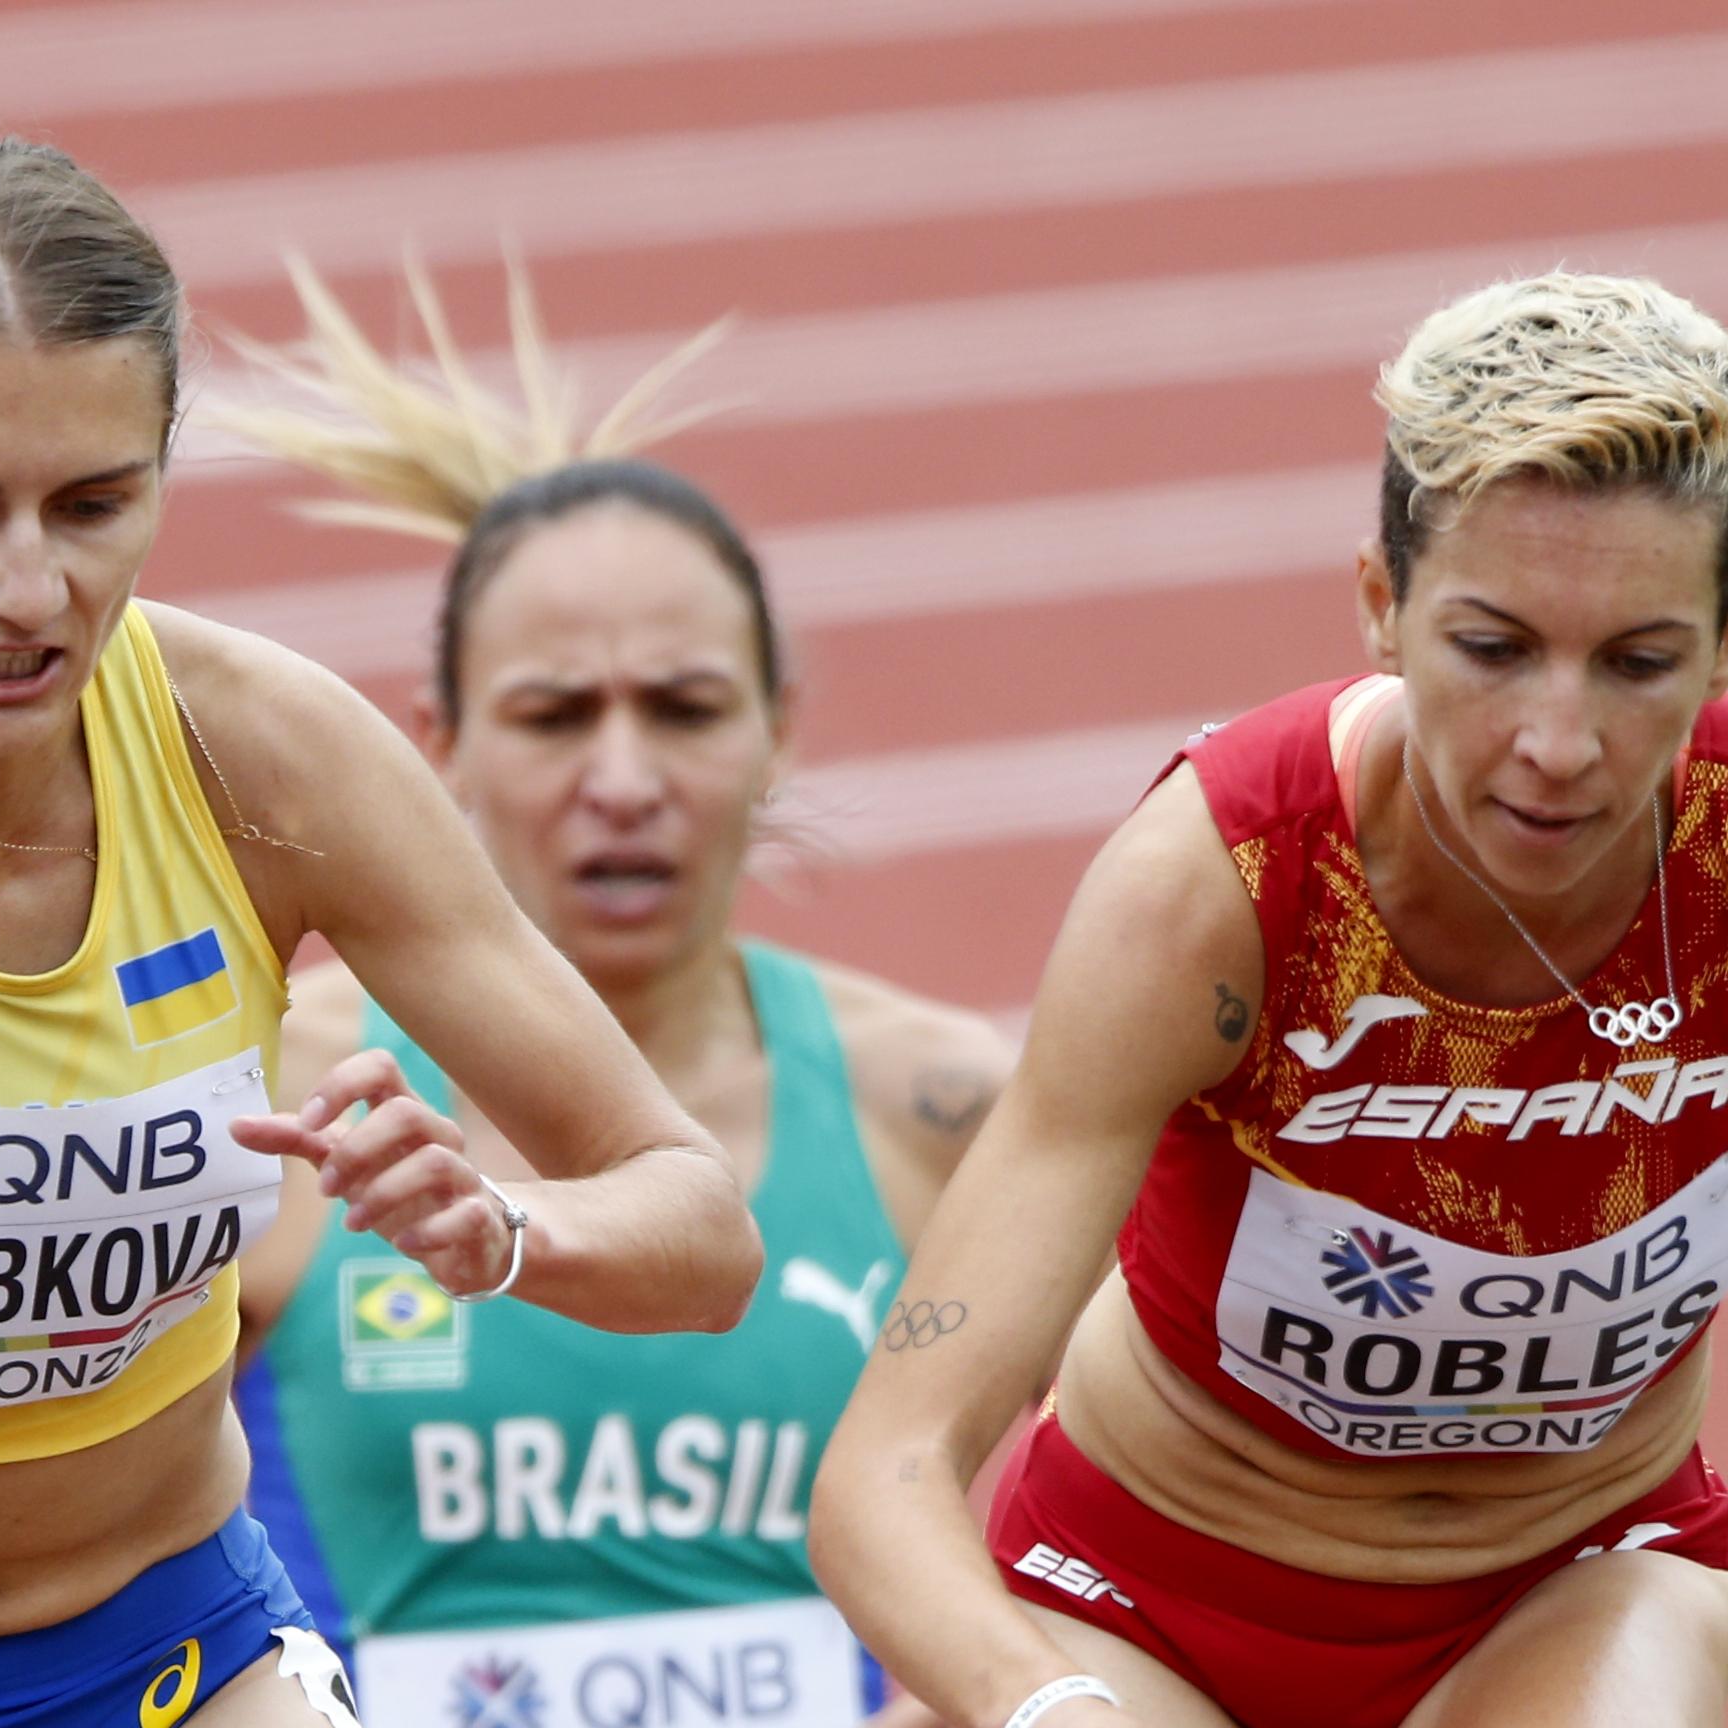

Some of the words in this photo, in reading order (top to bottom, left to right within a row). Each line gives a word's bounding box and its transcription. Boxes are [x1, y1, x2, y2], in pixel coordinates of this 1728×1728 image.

[1458, 1215, 1691, 1320] QNB
[1259, 1279, 1719, 1397] ROBLES
[410, 1413, 809, 1543] BRASIL
